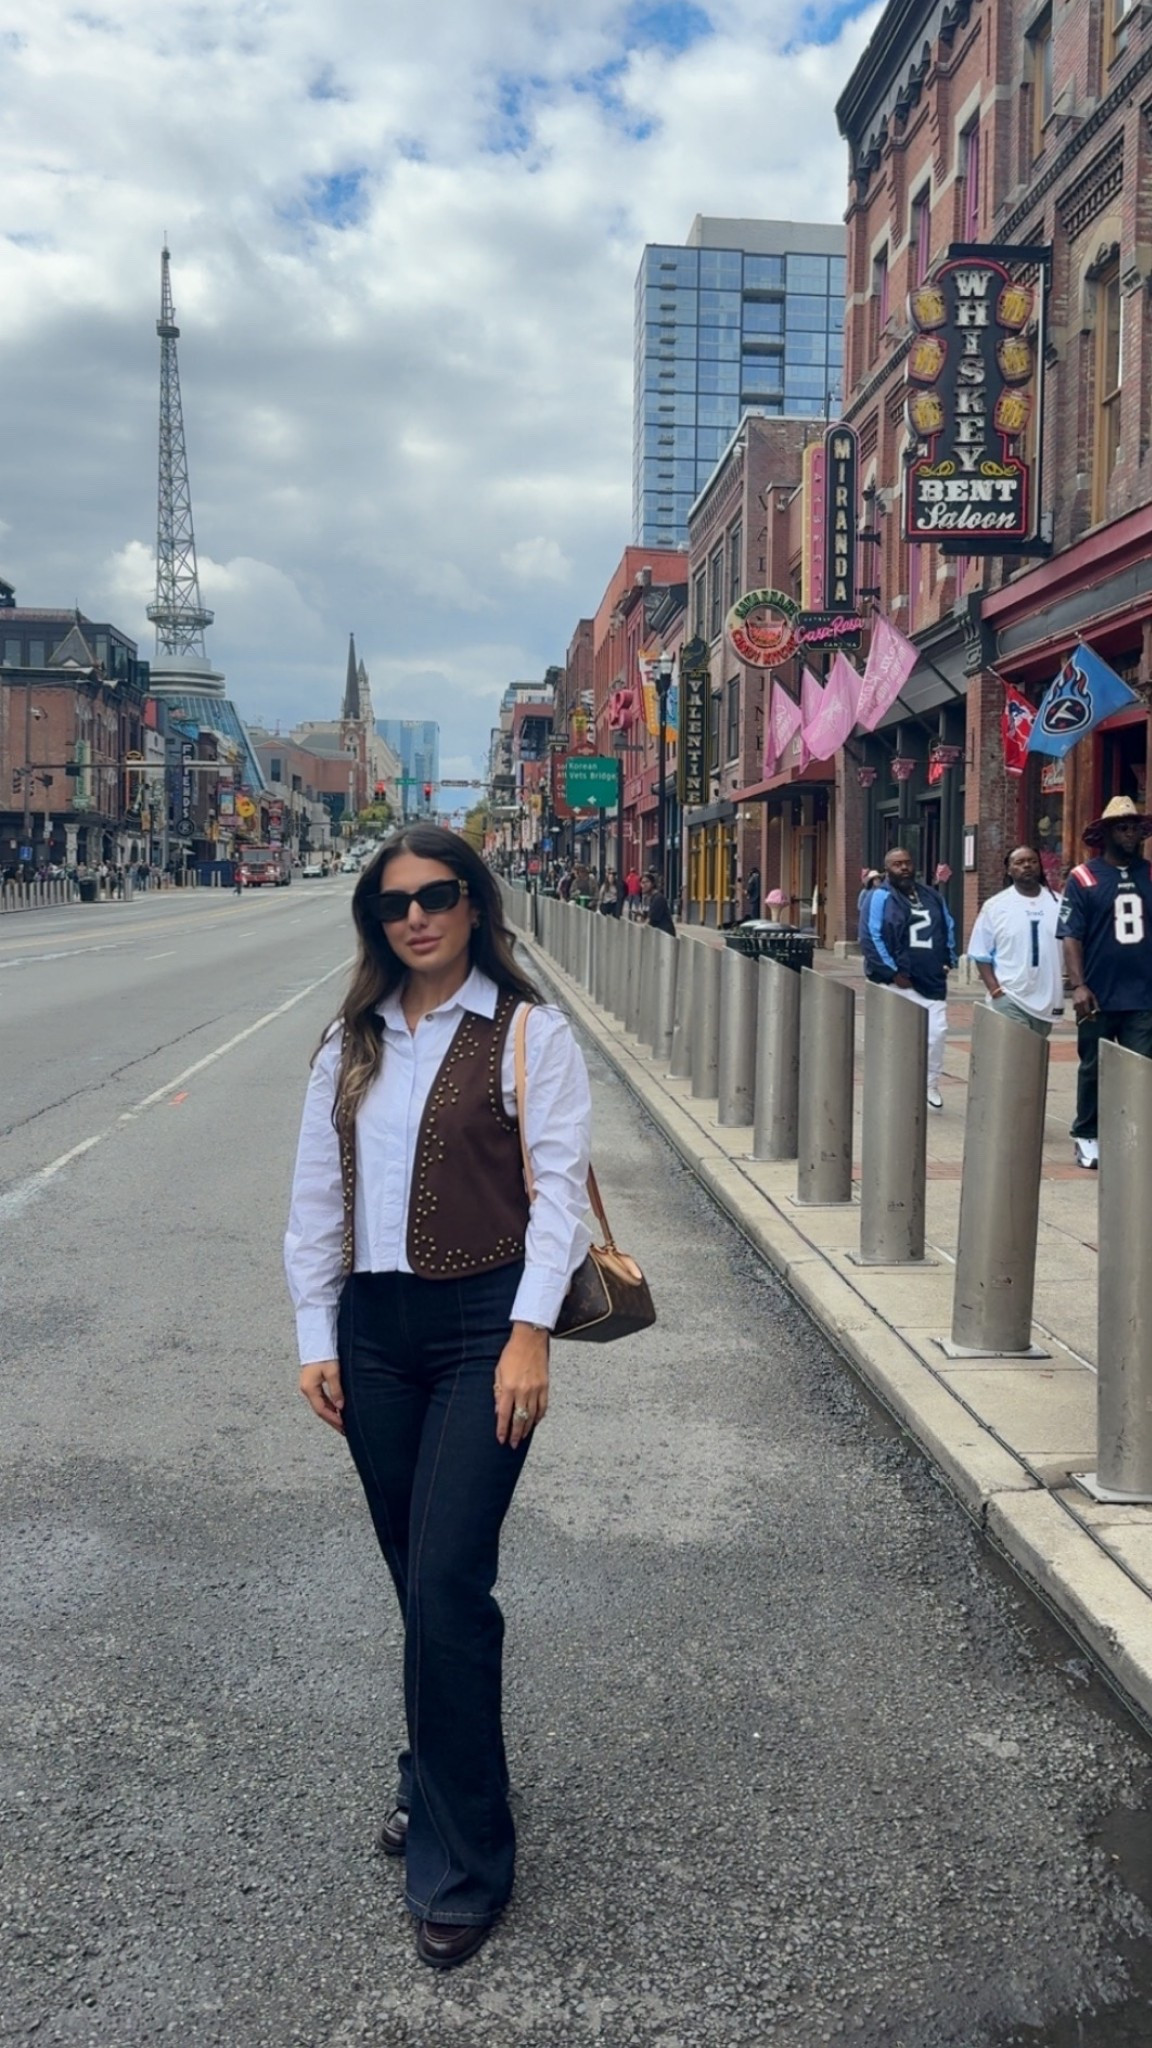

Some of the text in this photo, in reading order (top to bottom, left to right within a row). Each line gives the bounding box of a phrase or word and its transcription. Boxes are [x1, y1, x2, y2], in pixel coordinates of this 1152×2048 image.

[953, 271, 993, 472] WHISKEY
[919, 479, 1017, 502] BENT
[834, 438, 850, 601] MIRANDA
[917, 503, 1015, 530] Saloon
[831, 615, 864, 636] Rosa
[688, 680, 703, 802] VALENTINE
[569, 771, 588, 779] Vets
[590, 771, 617, 781] Bridge
[909, 909, 934, 949] 2
[1114, 893, 1145, 945] 8
[1029, 920, 1040, 968] 1
